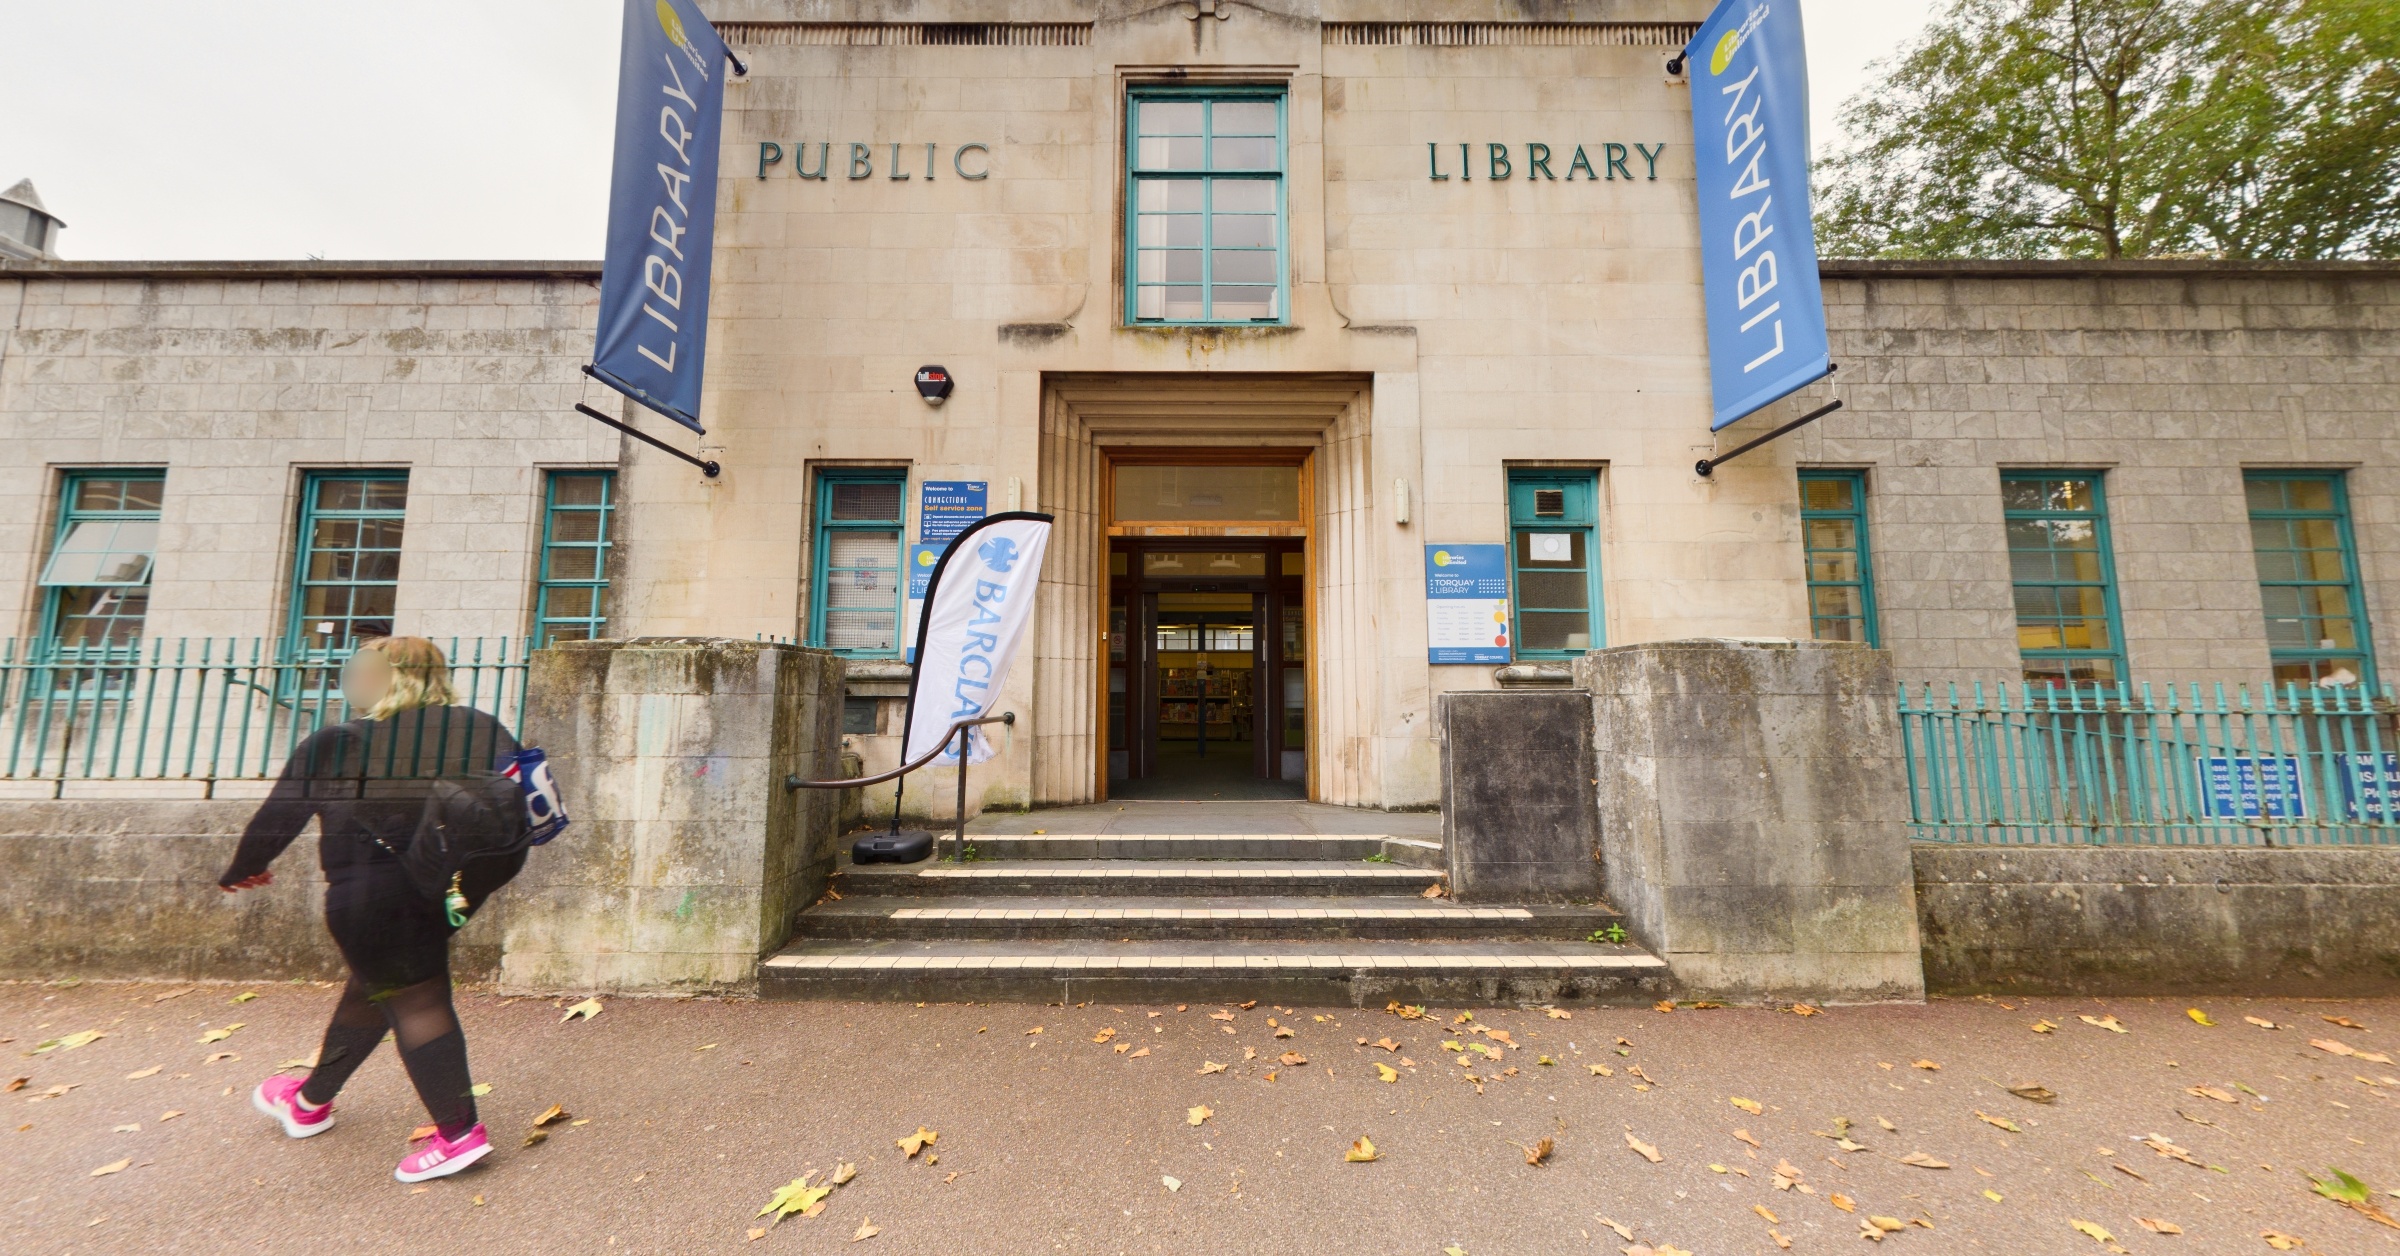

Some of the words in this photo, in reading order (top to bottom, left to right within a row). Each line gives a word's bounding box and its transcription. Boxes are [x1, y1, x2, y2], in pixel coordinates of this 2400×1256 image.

[671, 18, 707, 68] Libraries
[1724, 2, 1764, 52] Libraries
[1725, 4, 1770, 62] Unlimited
[756, 141, 989, 181] PUBLIC
[1427, 142, 1667, 181] LIBRARY
[637, 53, 697, 373] LIBRARY
[1722, 65, 1784, 373] LIBRARY
[924, 496, 967, 504] CONNECTIONS
[1434, 579, 1475, 587] TORQUAY
[1435, 586, 1469, 594] LIBRARY
